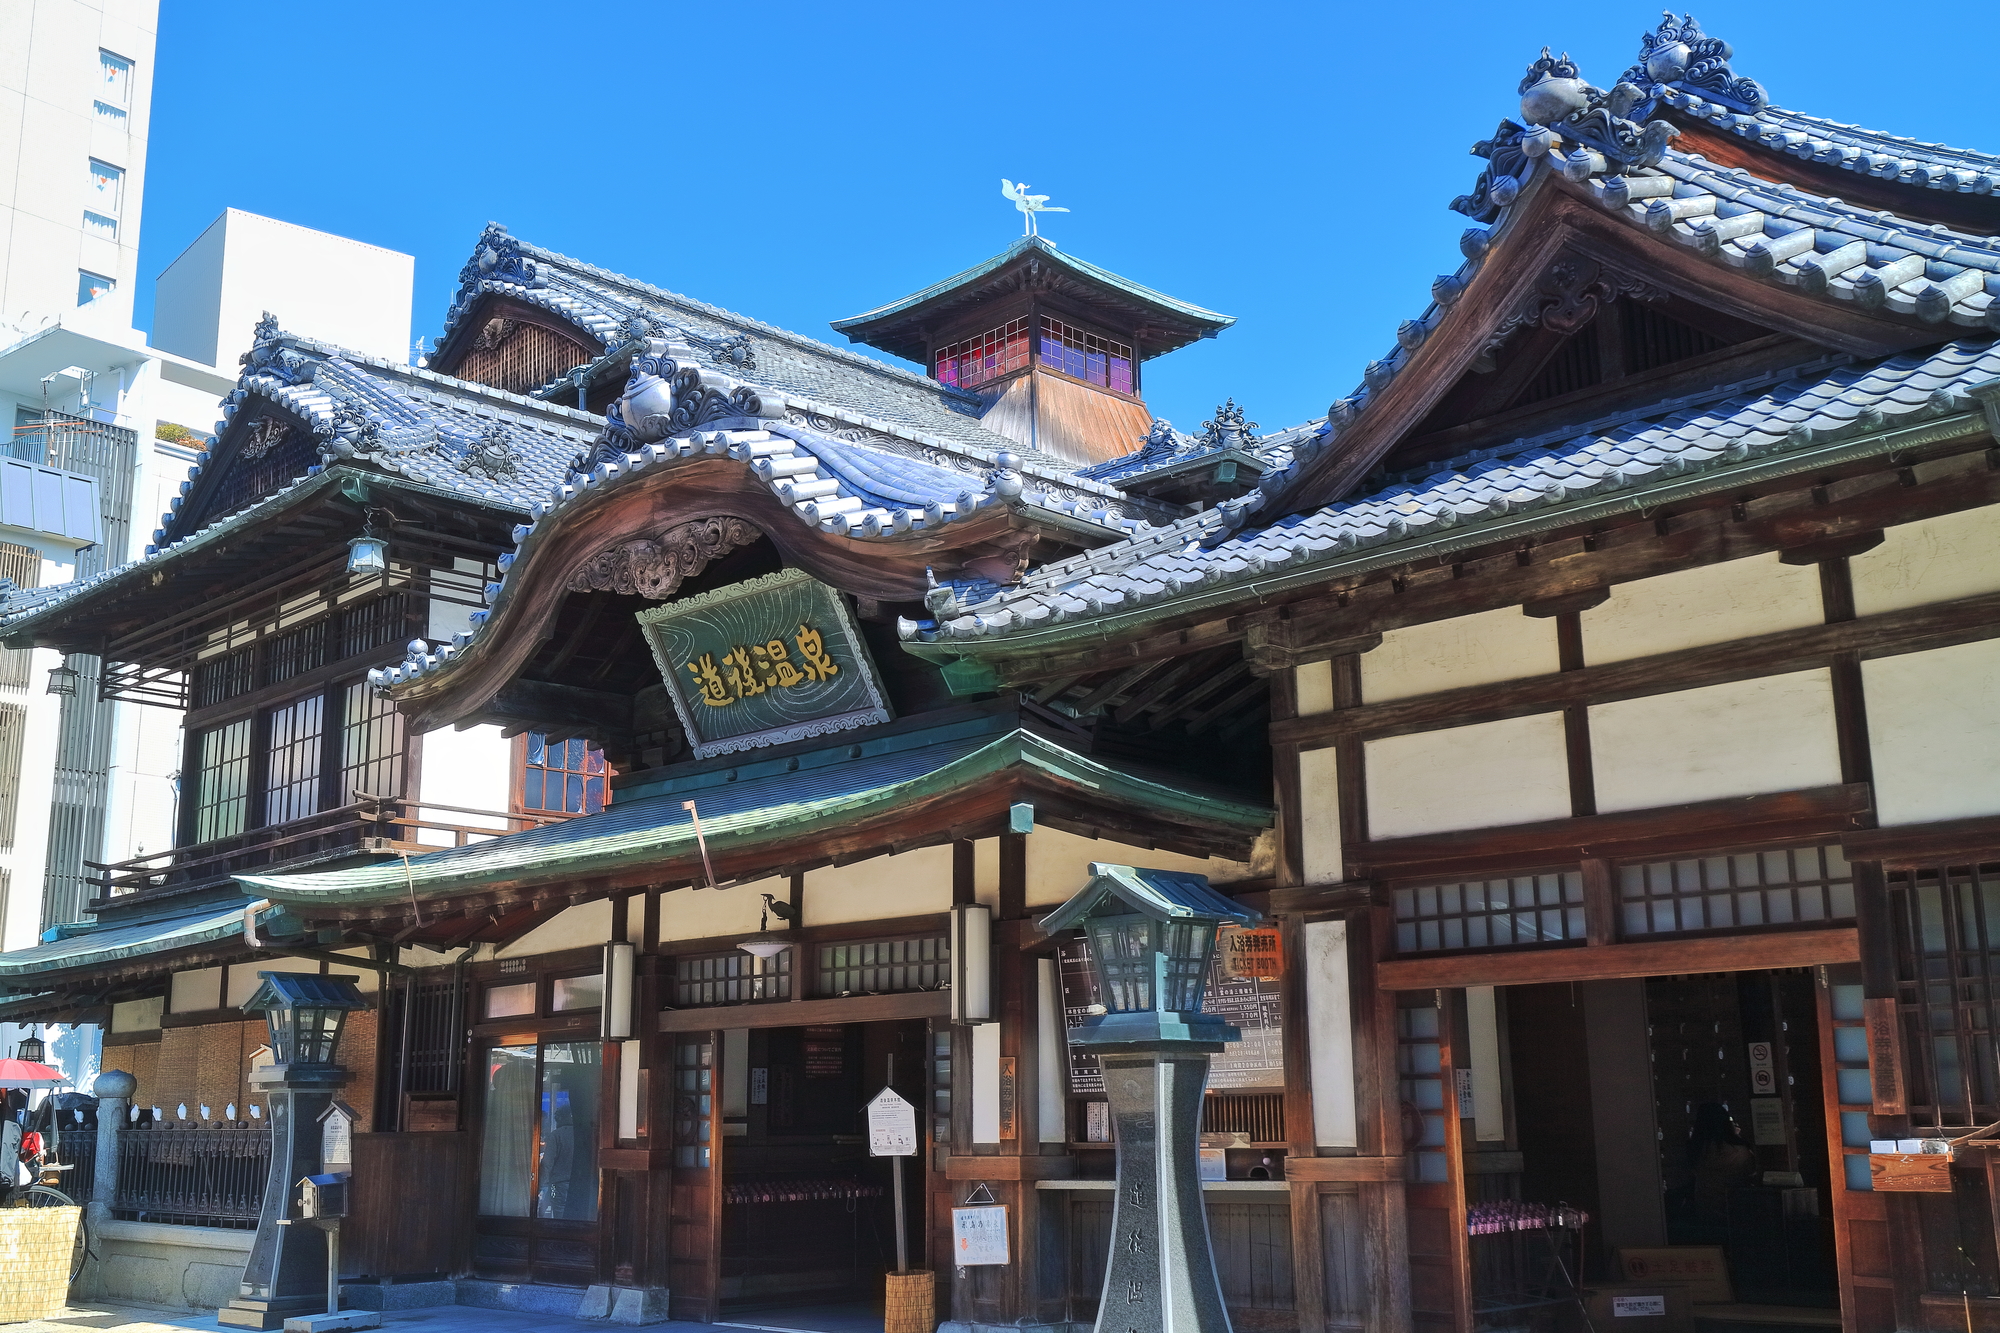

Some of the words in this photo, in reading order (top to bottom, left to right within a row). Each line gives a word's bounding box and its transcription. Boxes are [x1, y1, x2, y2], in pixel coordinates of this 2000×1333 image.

[687, 624, 838, 706] 道後温泉
[1229, 934, 1277, 952] 入浴券発売所
[1232, 957, 1254, 970] TICKET
[1256, 957, 1277, 970] BOOTH
[1126, 1181, 1145, 1333] 道後温
